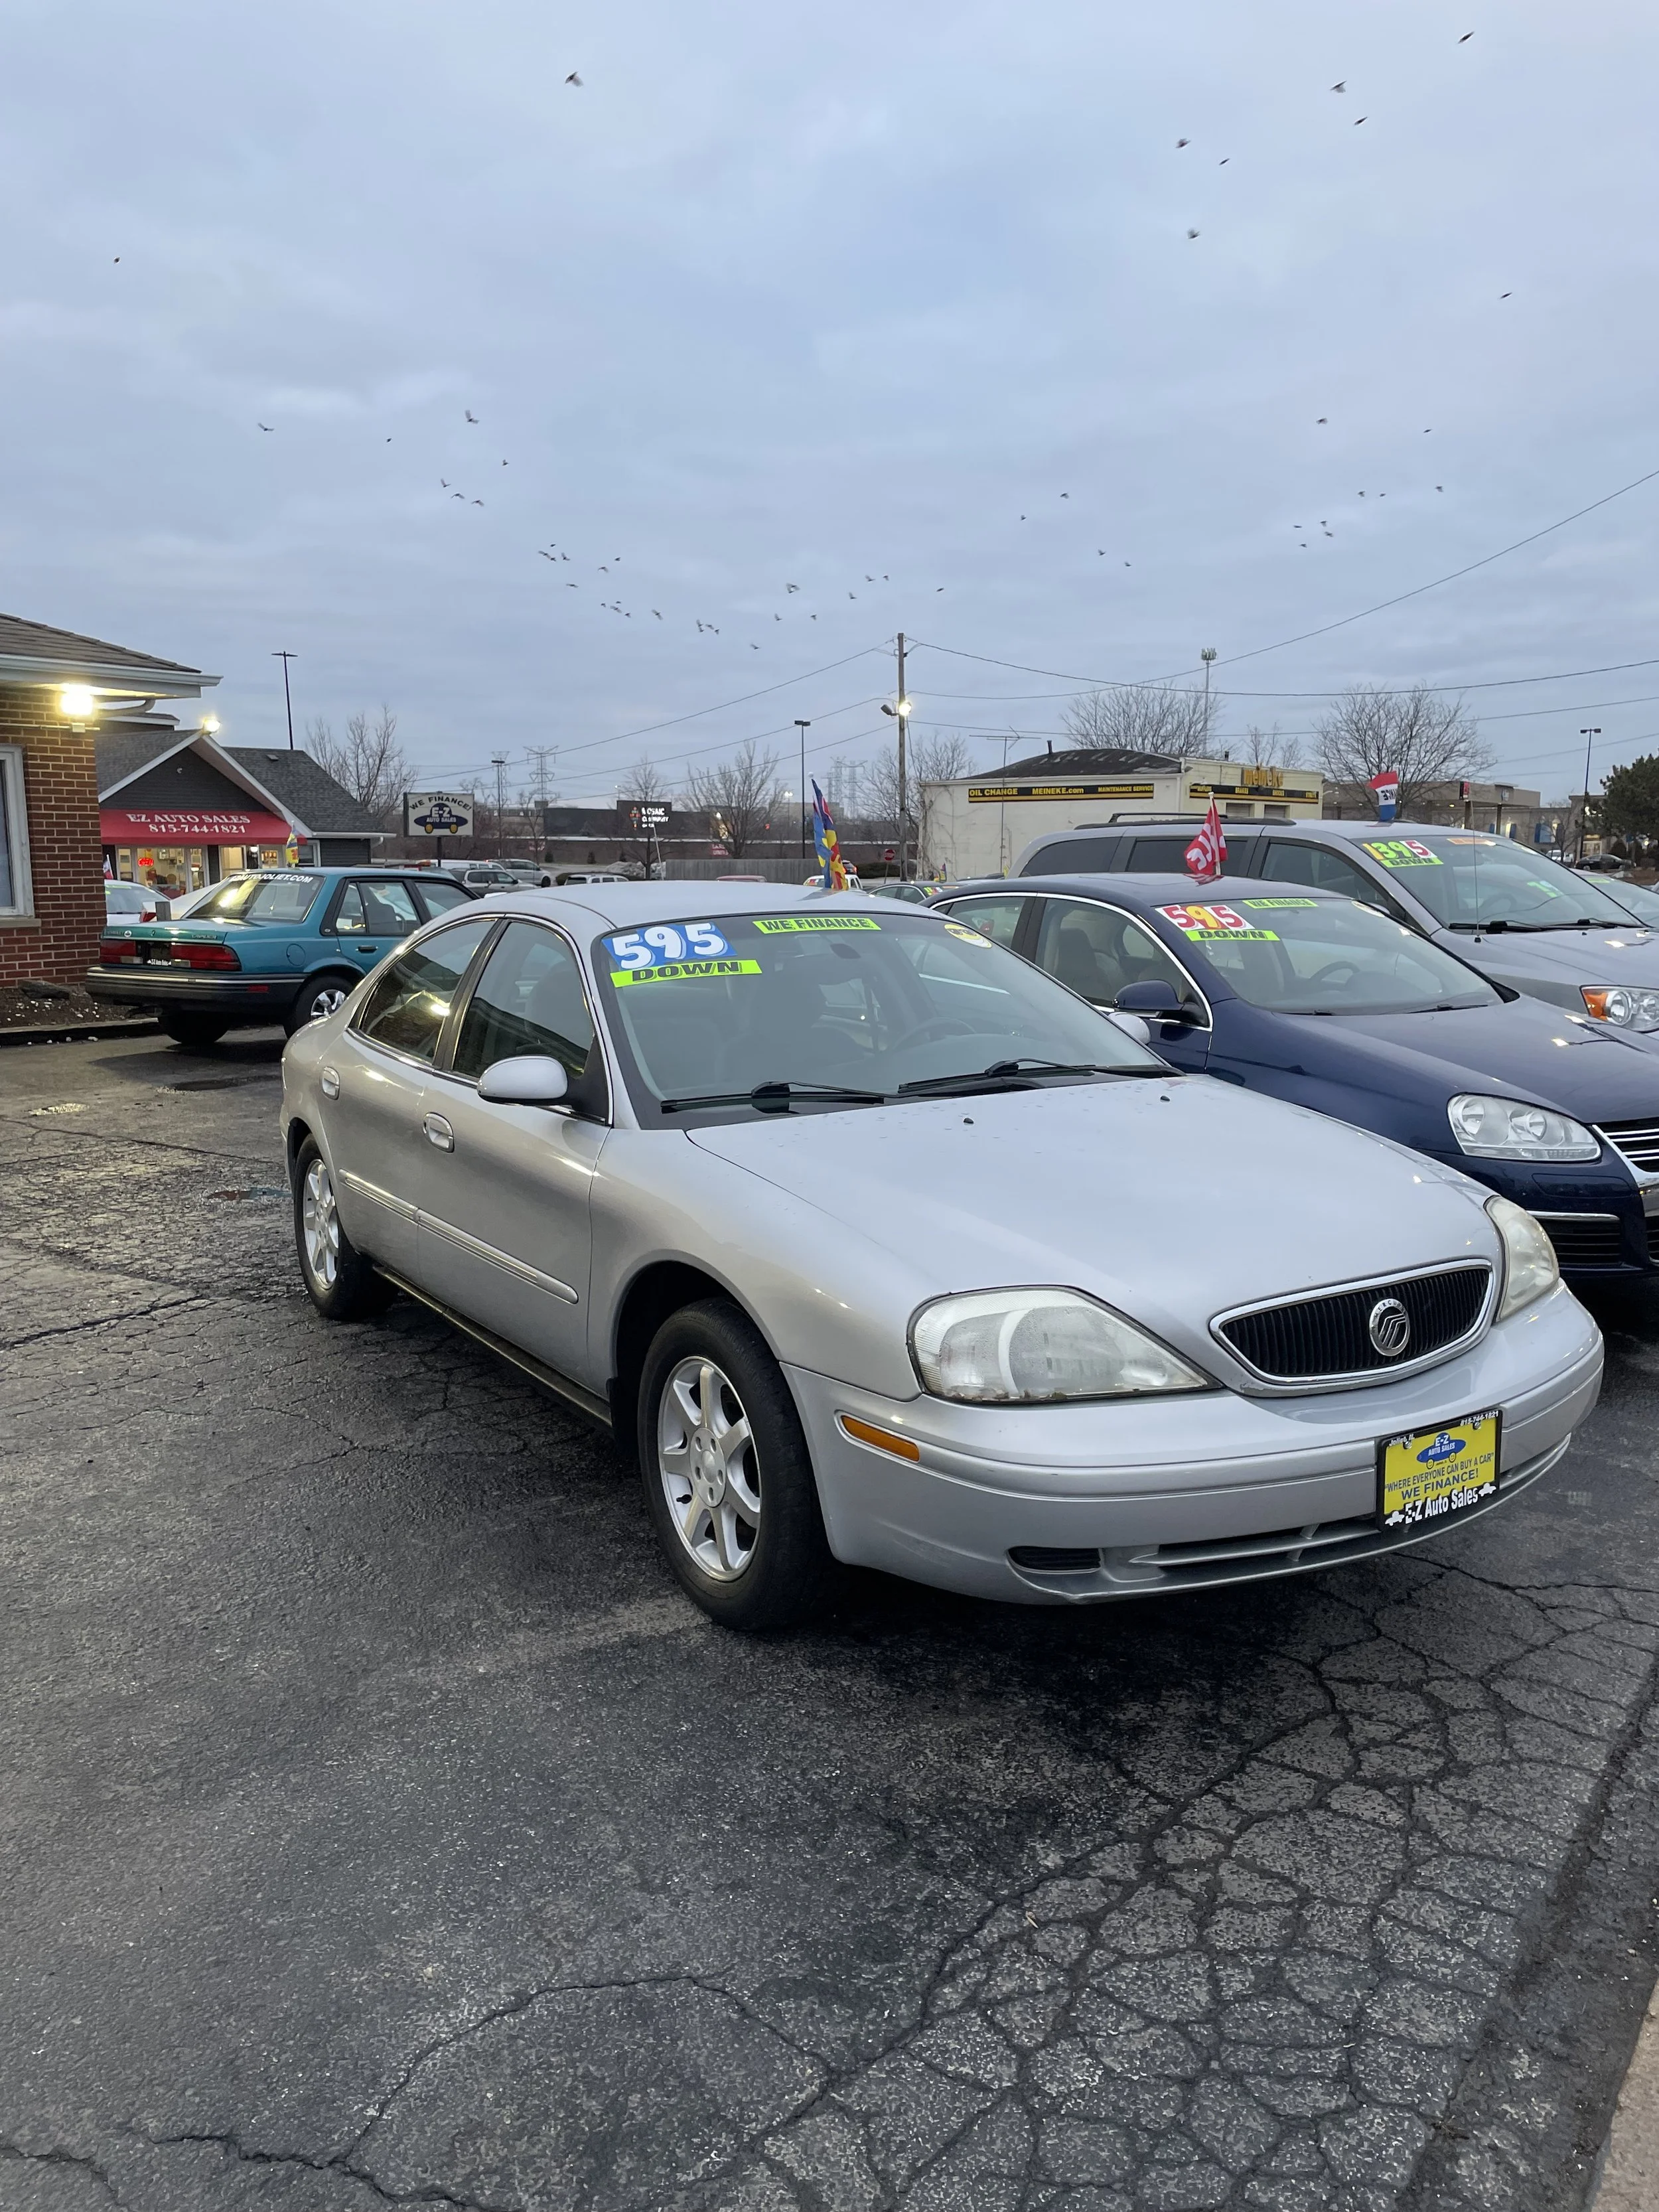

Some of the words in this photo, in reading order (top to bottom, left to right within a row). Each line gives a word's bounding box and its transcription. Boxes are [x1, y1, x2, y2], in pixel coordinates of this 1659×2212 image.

[409, 799, 425, 810] WE
[428, 796, 472, 811] FINANCE!
[431, 806, 451, 817] E-Z
[126, 814, 151, 822] EZ
[155, 814, 199, 823] AUTO
[202, 815, 250, 824] SALES
[149, 824, 246, 834] 815-744-1821
[1389, 857, 1436, 865] DOWN
[761, 920, 792, 931] WE
[796, 917, 871, 929] FINANCE
[1162, 905, 1245, 929] 595
[1198, 930, 1267, 939] DOWN
[613, 922, 728, 970] 595
[632, 961, 741, 982] DOWN
[1460, 1410, 1498, 1426] 815-744-1821
[1435, 1434, 1449, 1447] E-Z
[1428, 1446, 1441, 1456] AUTO
[1441, 1442, 1455, 1452] SALES
[1412, 1469, 1445, 1485] EVERYONE
[1447, 1465, 1459, 1474] CAN
[1460, 1458, 1473, 1470] BUY
[1401, 1486, 1420, 1500] WE
[1424, 1467, 1479, 1493] FINANCE!
[1405, 1500, 1423, 1524] E-Z
[1425, 1495, 1449, 1518] Auto
[1451, 1485, 1479, 1510] Sales
